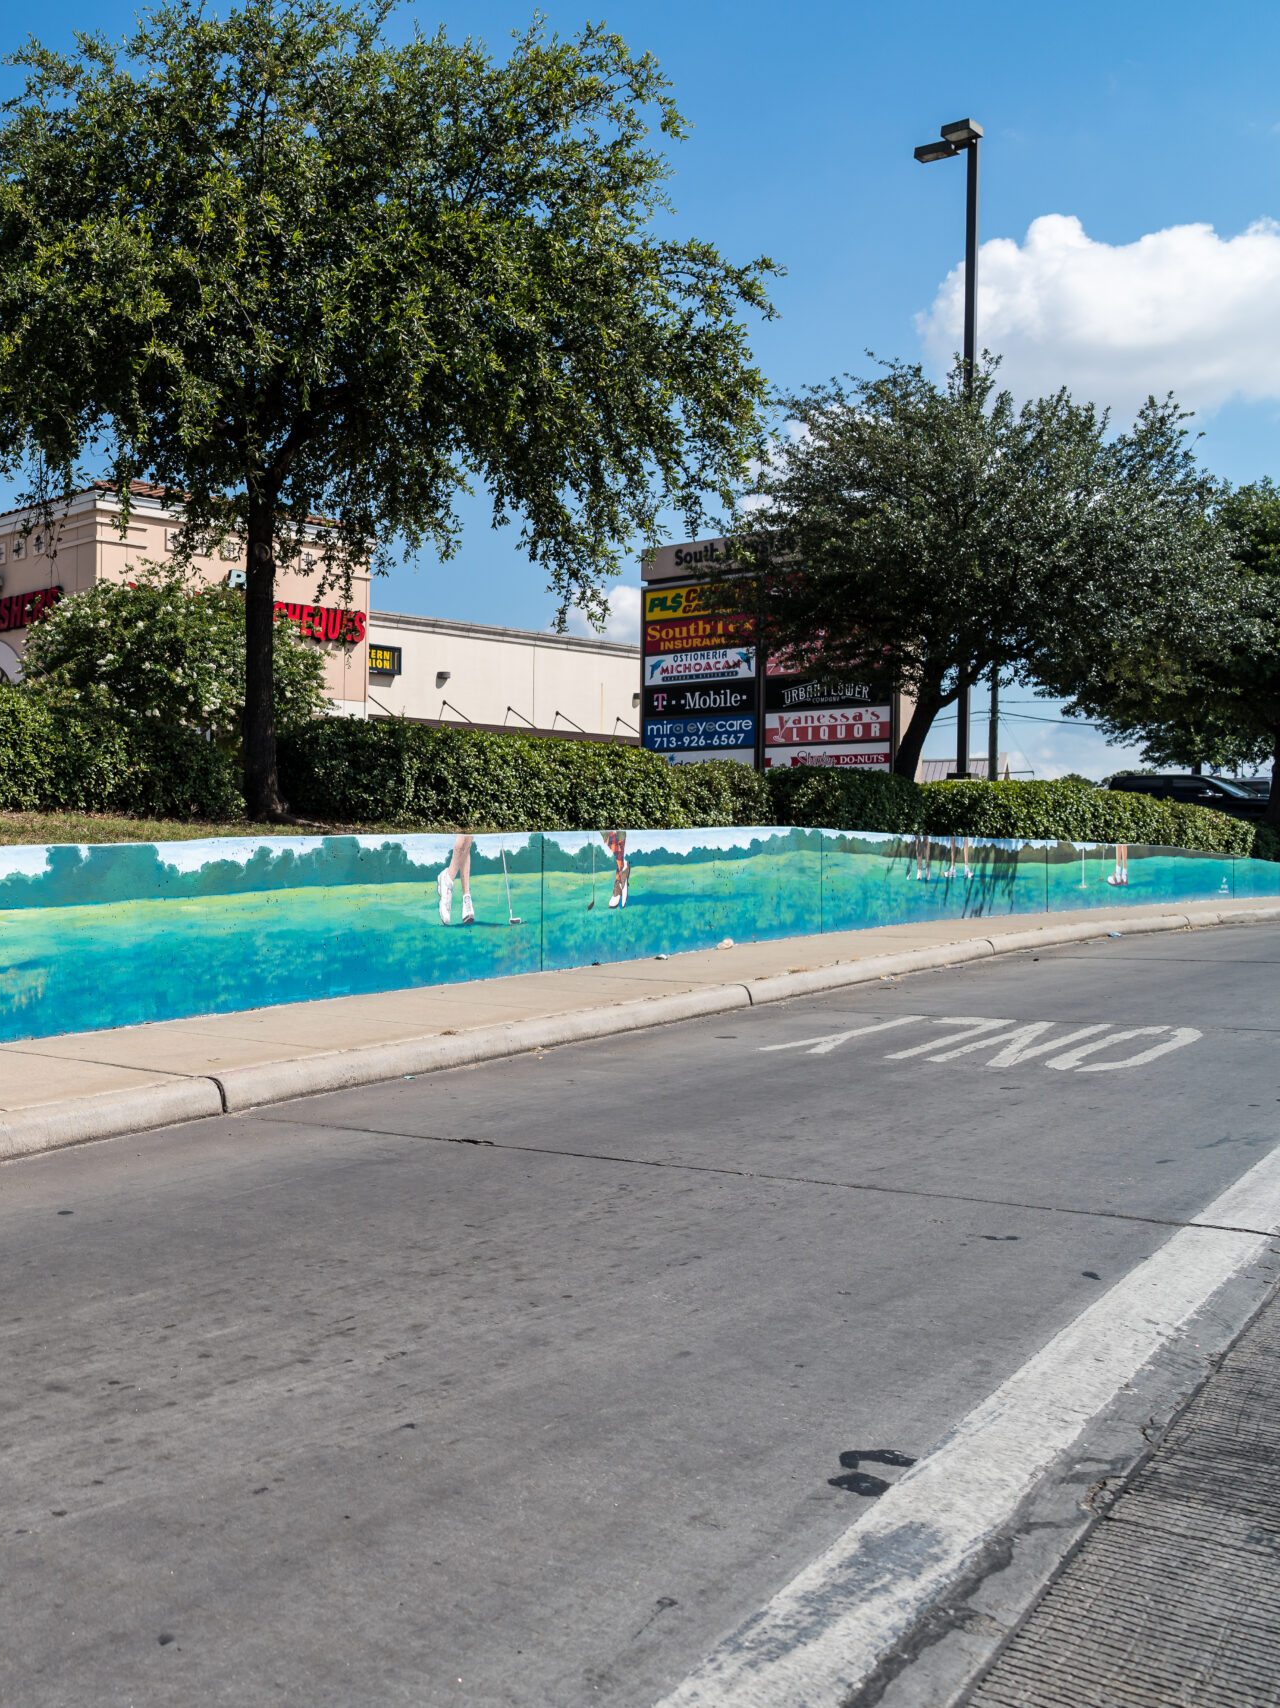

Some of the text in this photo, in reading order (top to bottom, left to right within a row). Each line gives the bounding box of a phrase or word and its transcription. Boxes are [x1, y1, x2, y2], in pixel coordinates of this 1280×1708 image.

[273, 601, 367, 642] CHEQUES
[673, 650, 728, 663] OSTIONERIA
[647, 719, 753, 736] mira eyecare
[792, 723, 881, 741] LIQUOR
[654, 733, 745, 749] 713-926-6567
[839, 754, 886, 765] DO-NUTS
[757, 1015, 1204, 1073] ONLY
